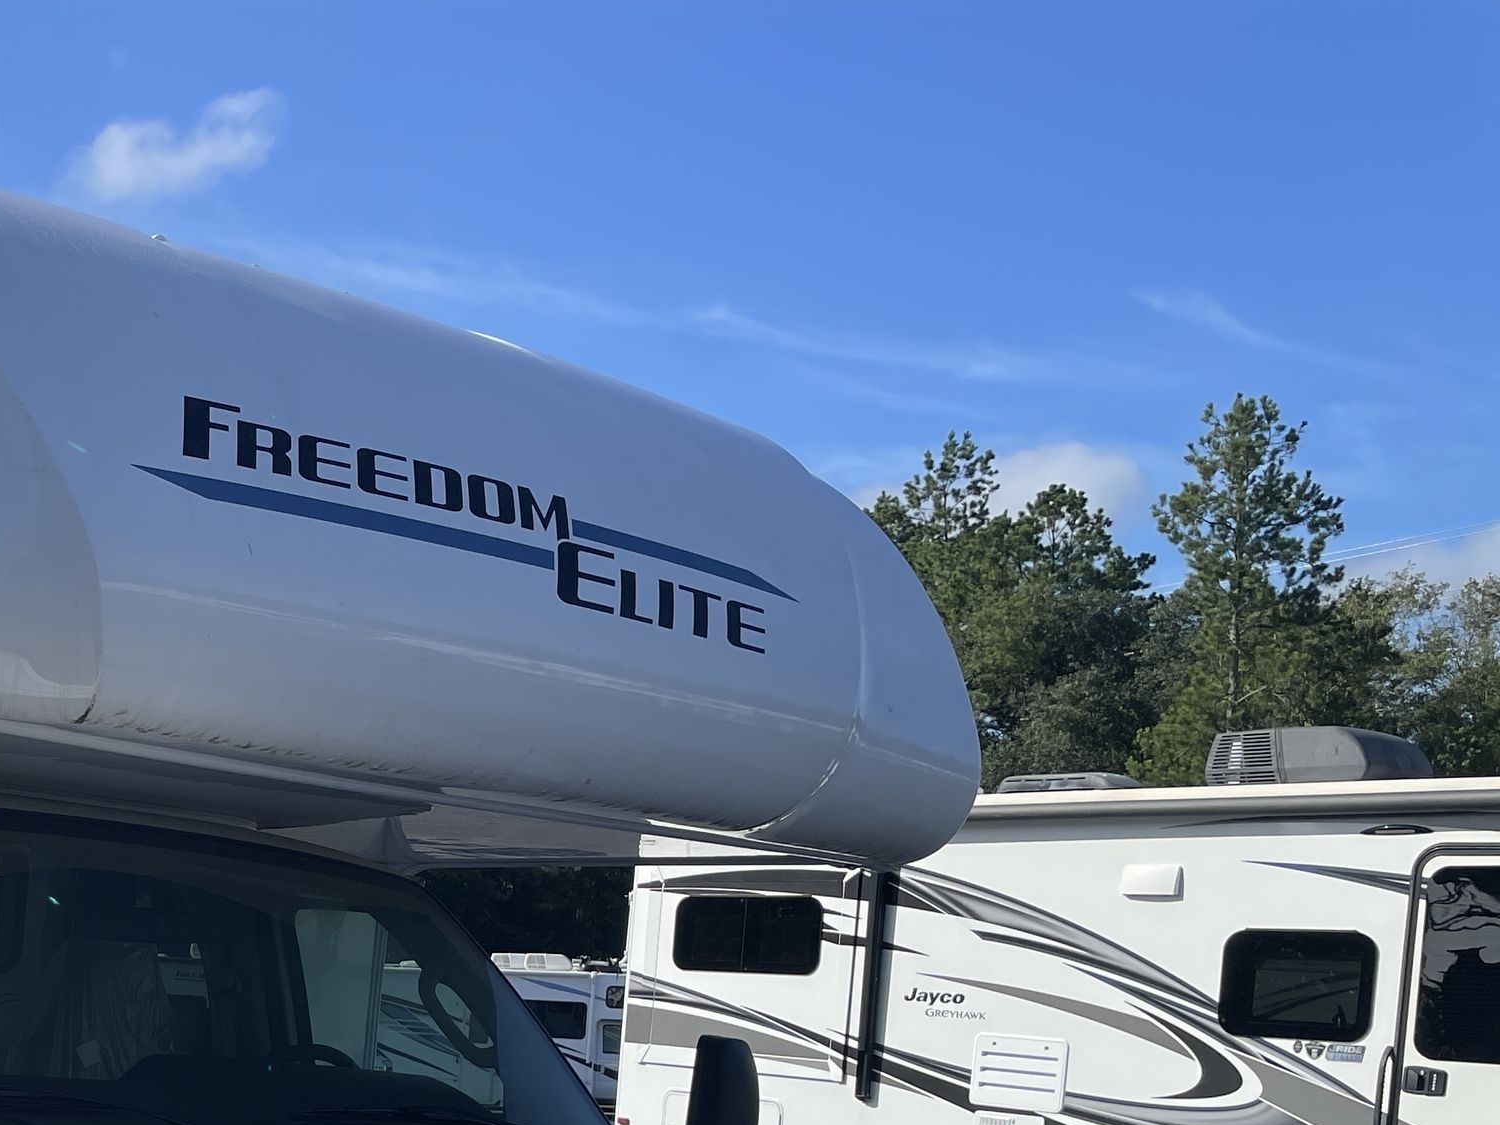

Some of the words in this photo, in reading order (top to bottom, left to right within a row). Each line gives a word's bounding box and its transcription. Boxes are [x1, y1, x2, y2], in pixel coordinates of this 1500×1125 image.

[182, 395, 570, 541] FREEDOM
[557, 541, 766, 655] ELITE
[904, 987, 965, 1006] Jayco
[925, 1008, 987, 1020] GREYHAWK
